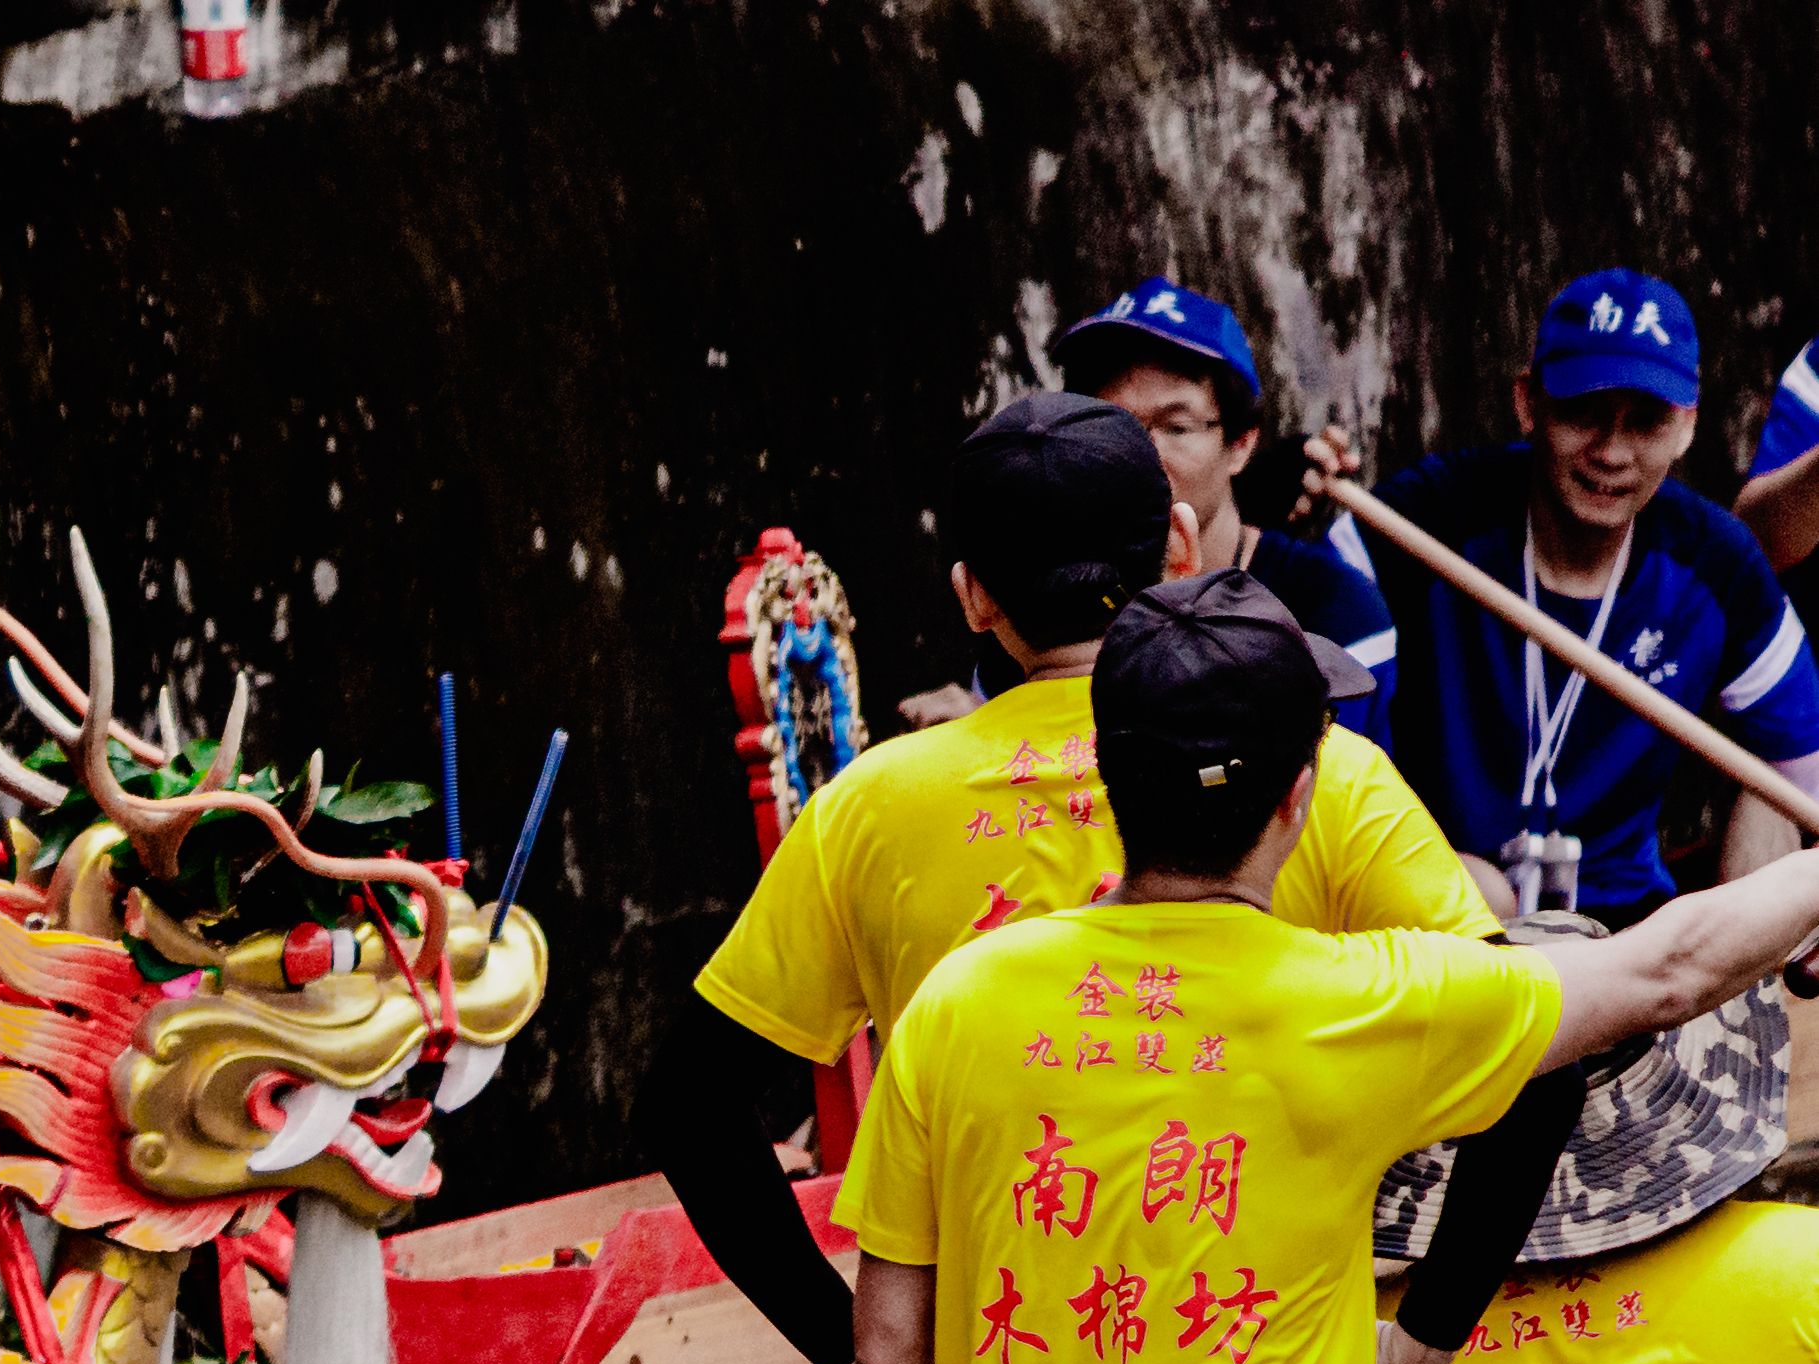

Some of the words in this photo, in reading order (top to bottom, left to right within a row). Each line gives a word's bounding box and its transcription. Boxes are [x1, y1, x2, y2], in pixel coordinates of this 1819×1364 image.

[1064, 961, 1185, 1023] 金裝
[1022, 1030, 1229, 1076] 九江雙蒸
[1012, 1112, 1248, 1240] 南朗
[1462, 1288, 1649, 1358] 九江雙蒸
